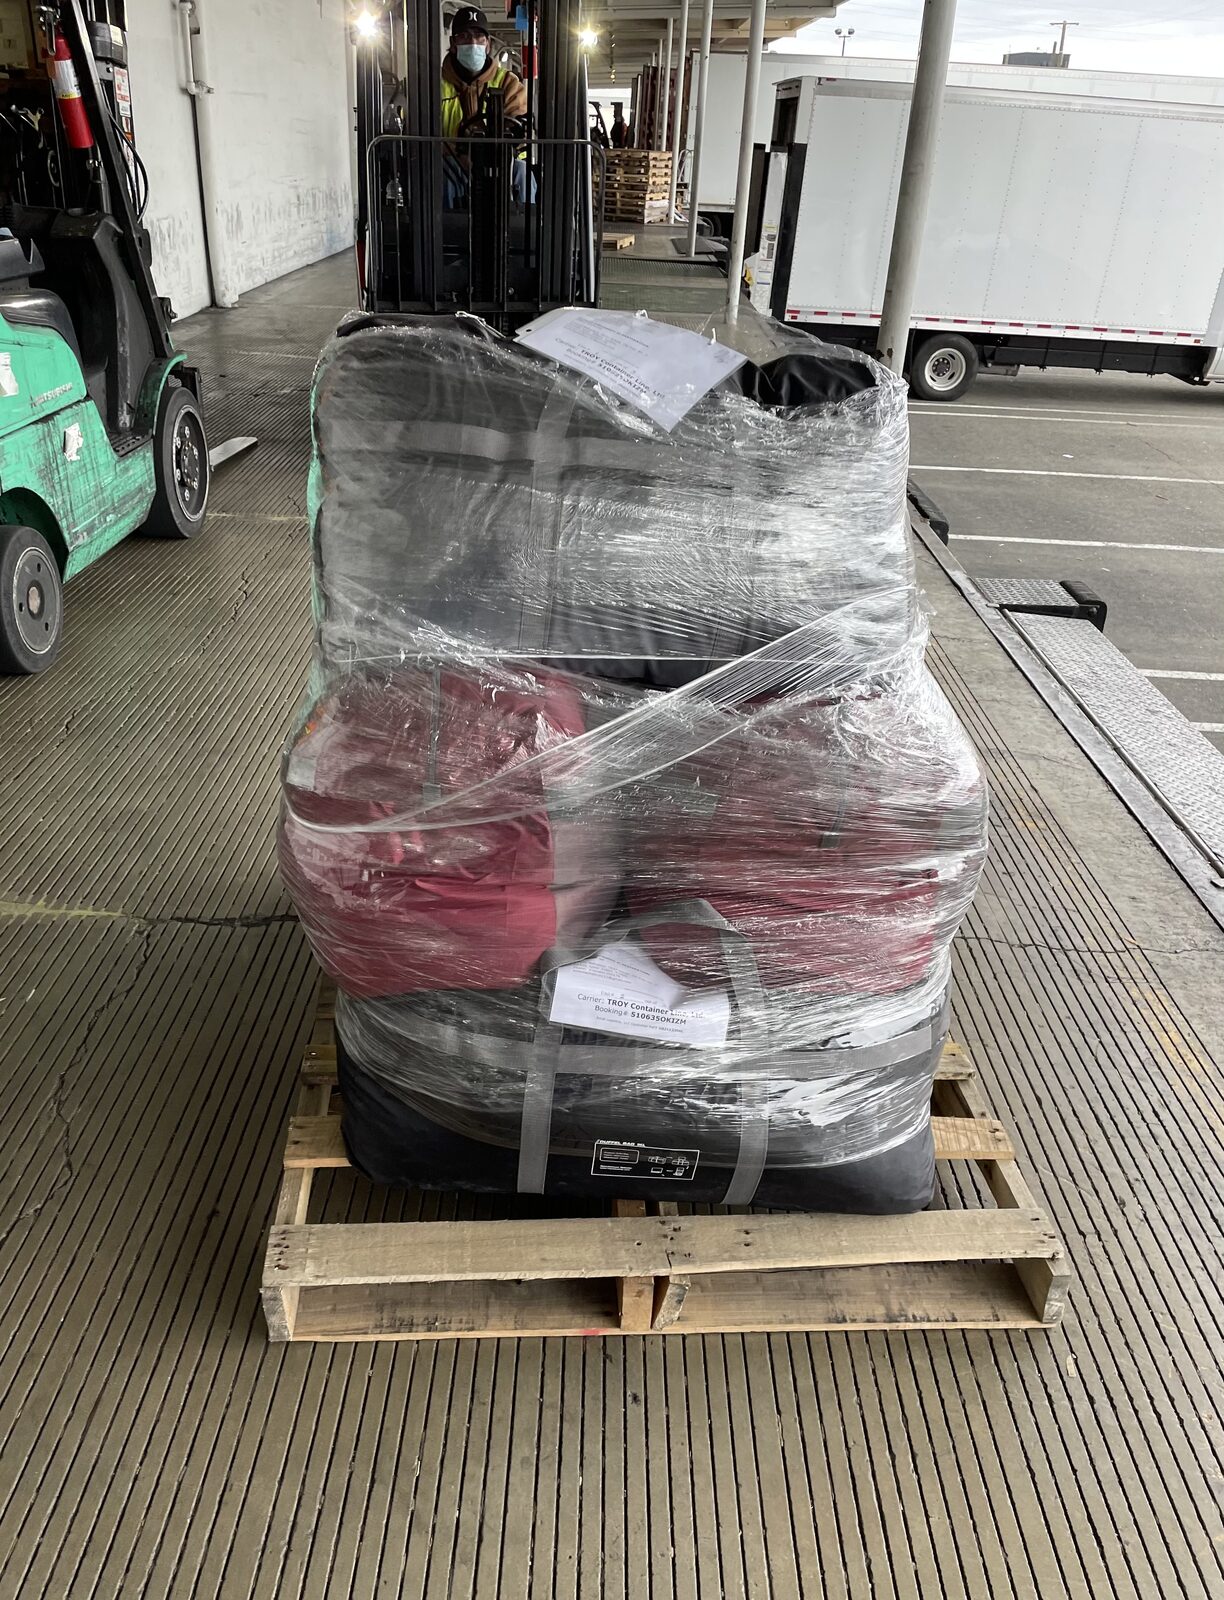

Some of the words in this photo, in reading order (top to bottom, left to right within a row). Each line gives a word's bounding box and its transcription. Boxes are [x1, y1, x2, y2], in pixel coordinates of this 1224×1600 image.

[581, 349, 601, 360] TROY
[600, 359, 635, 379] Container
[577, 993, 605, 1004] Carrier:
[607, 998, 629, 1008] TROY
[630, 1002, 669, 1015] Container
